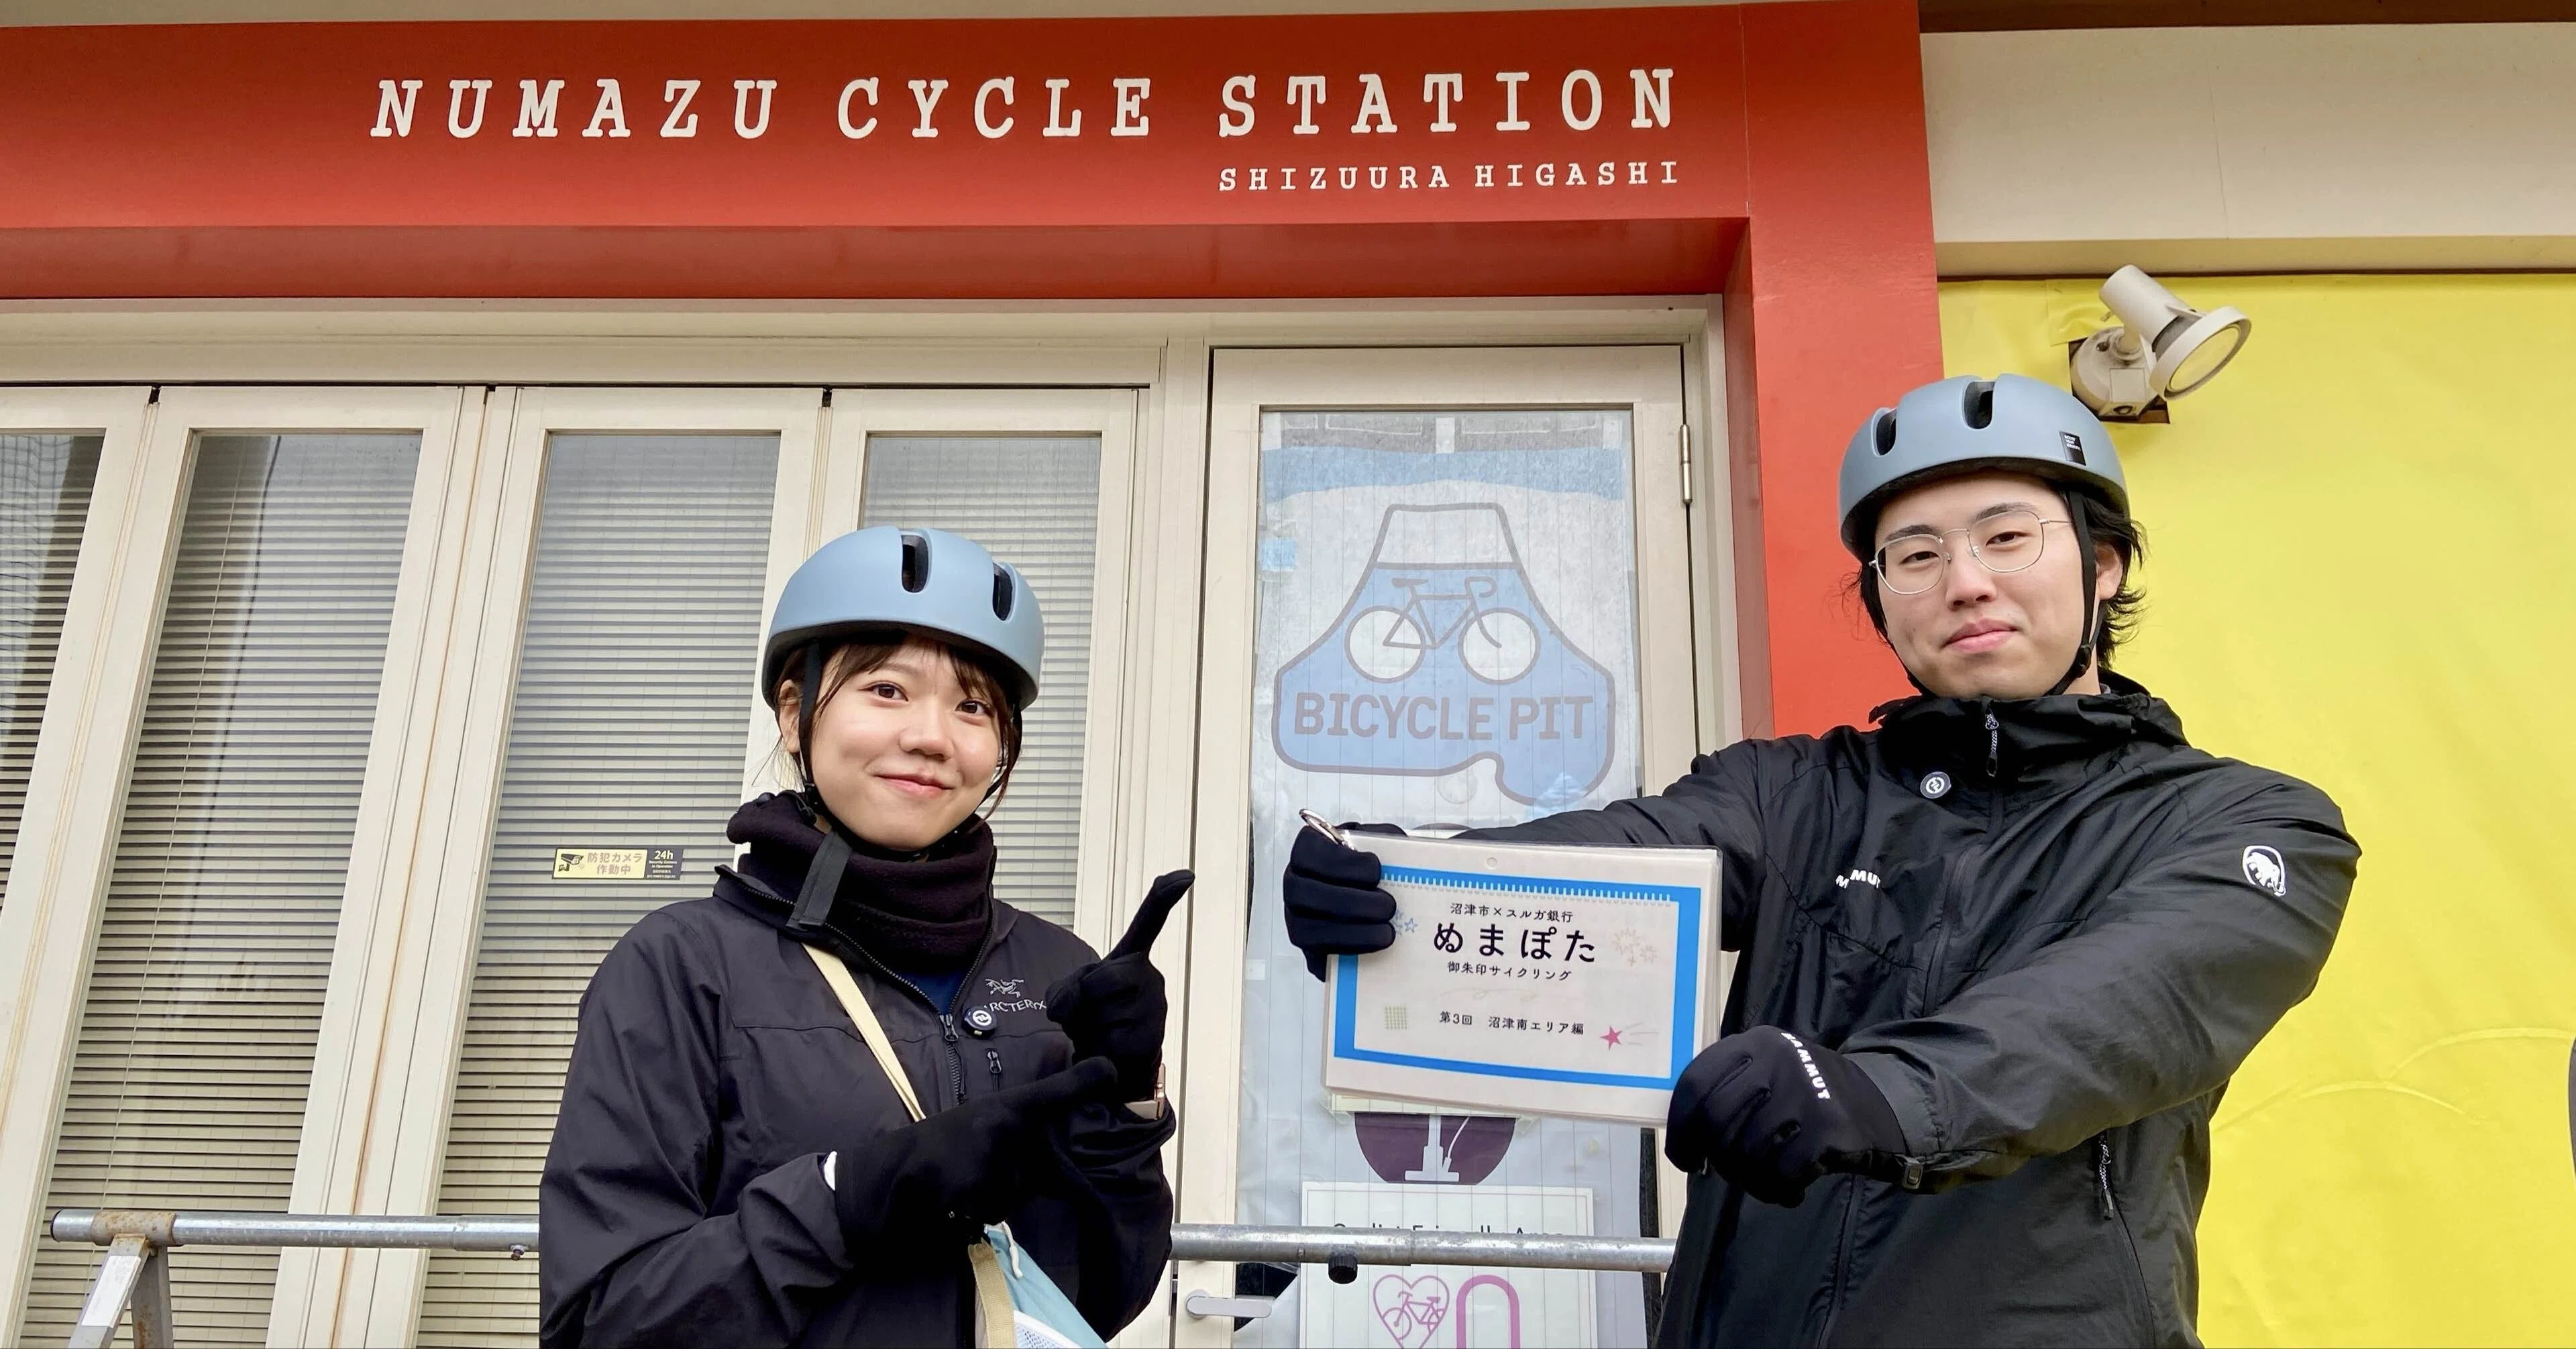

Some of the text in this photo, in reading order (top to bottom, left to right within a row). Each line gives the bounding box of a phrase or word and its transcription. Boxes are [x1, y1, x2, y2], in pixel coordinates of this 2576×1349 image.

[370, 68, 1674, 139] NUMAZU CYCLE STATION
[1219, 161, 1678, 191] SHIZUURA HIGASHI
[1294, 692, 1593, 740] BICYCLE PIT
[588, 853, 642, 863] 防犯カメラ
[654, 850, 674, 859] 24h
[597, 864, 631, 875] 作動中
[1434, 922, 1595, 963] ぬまぽた
[1448, 961, 1572, 981] 御朱印サイクリング
[1440, 1011, 1585, 1035] 第3回 沼津南エリア編
